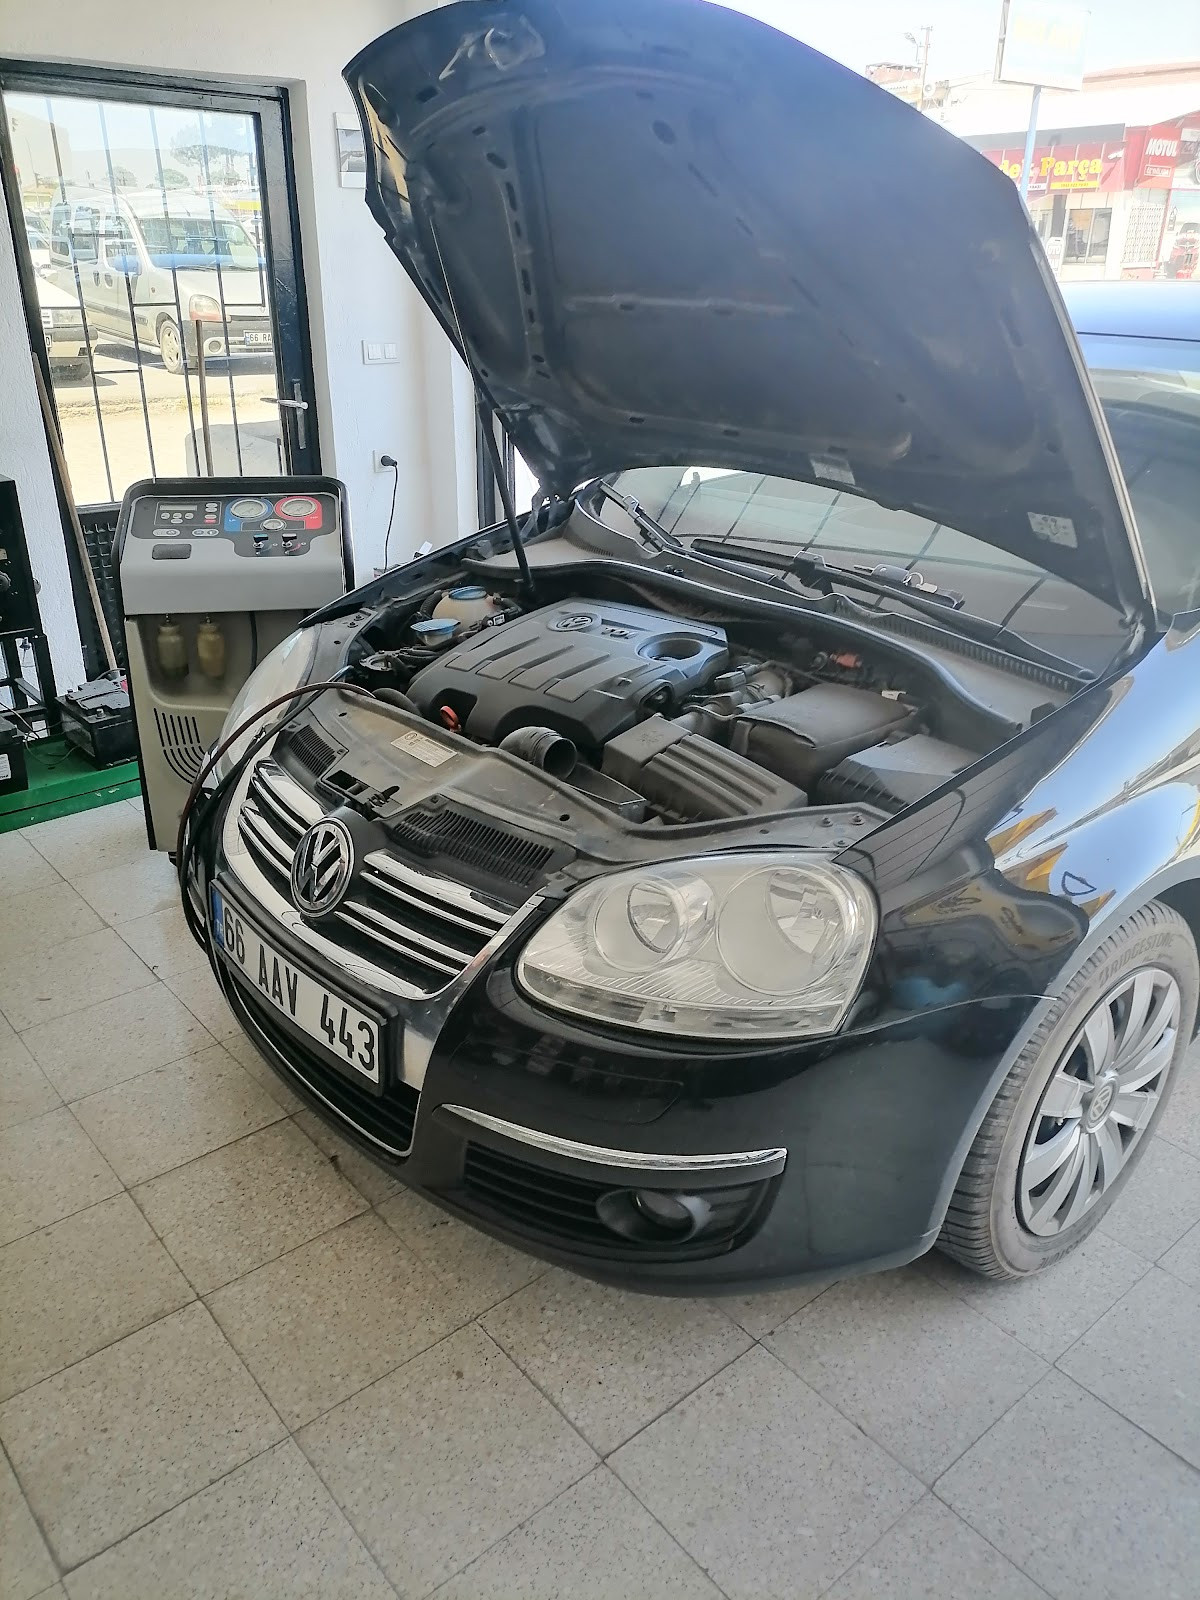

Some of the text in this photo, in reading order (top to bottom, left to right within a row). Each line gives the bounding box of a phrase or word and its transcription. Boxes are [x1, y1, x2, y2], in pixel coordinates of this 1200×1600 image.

[1145, 138, 1178, 157] MOTUL
[1039, 157, 1103, 181] Parça
[249, 334, 259, 342] 66
[1099, 932, 1175, 989] BRIDGESTONE
[224, 906, 375, 1072] 66 AAV 443
